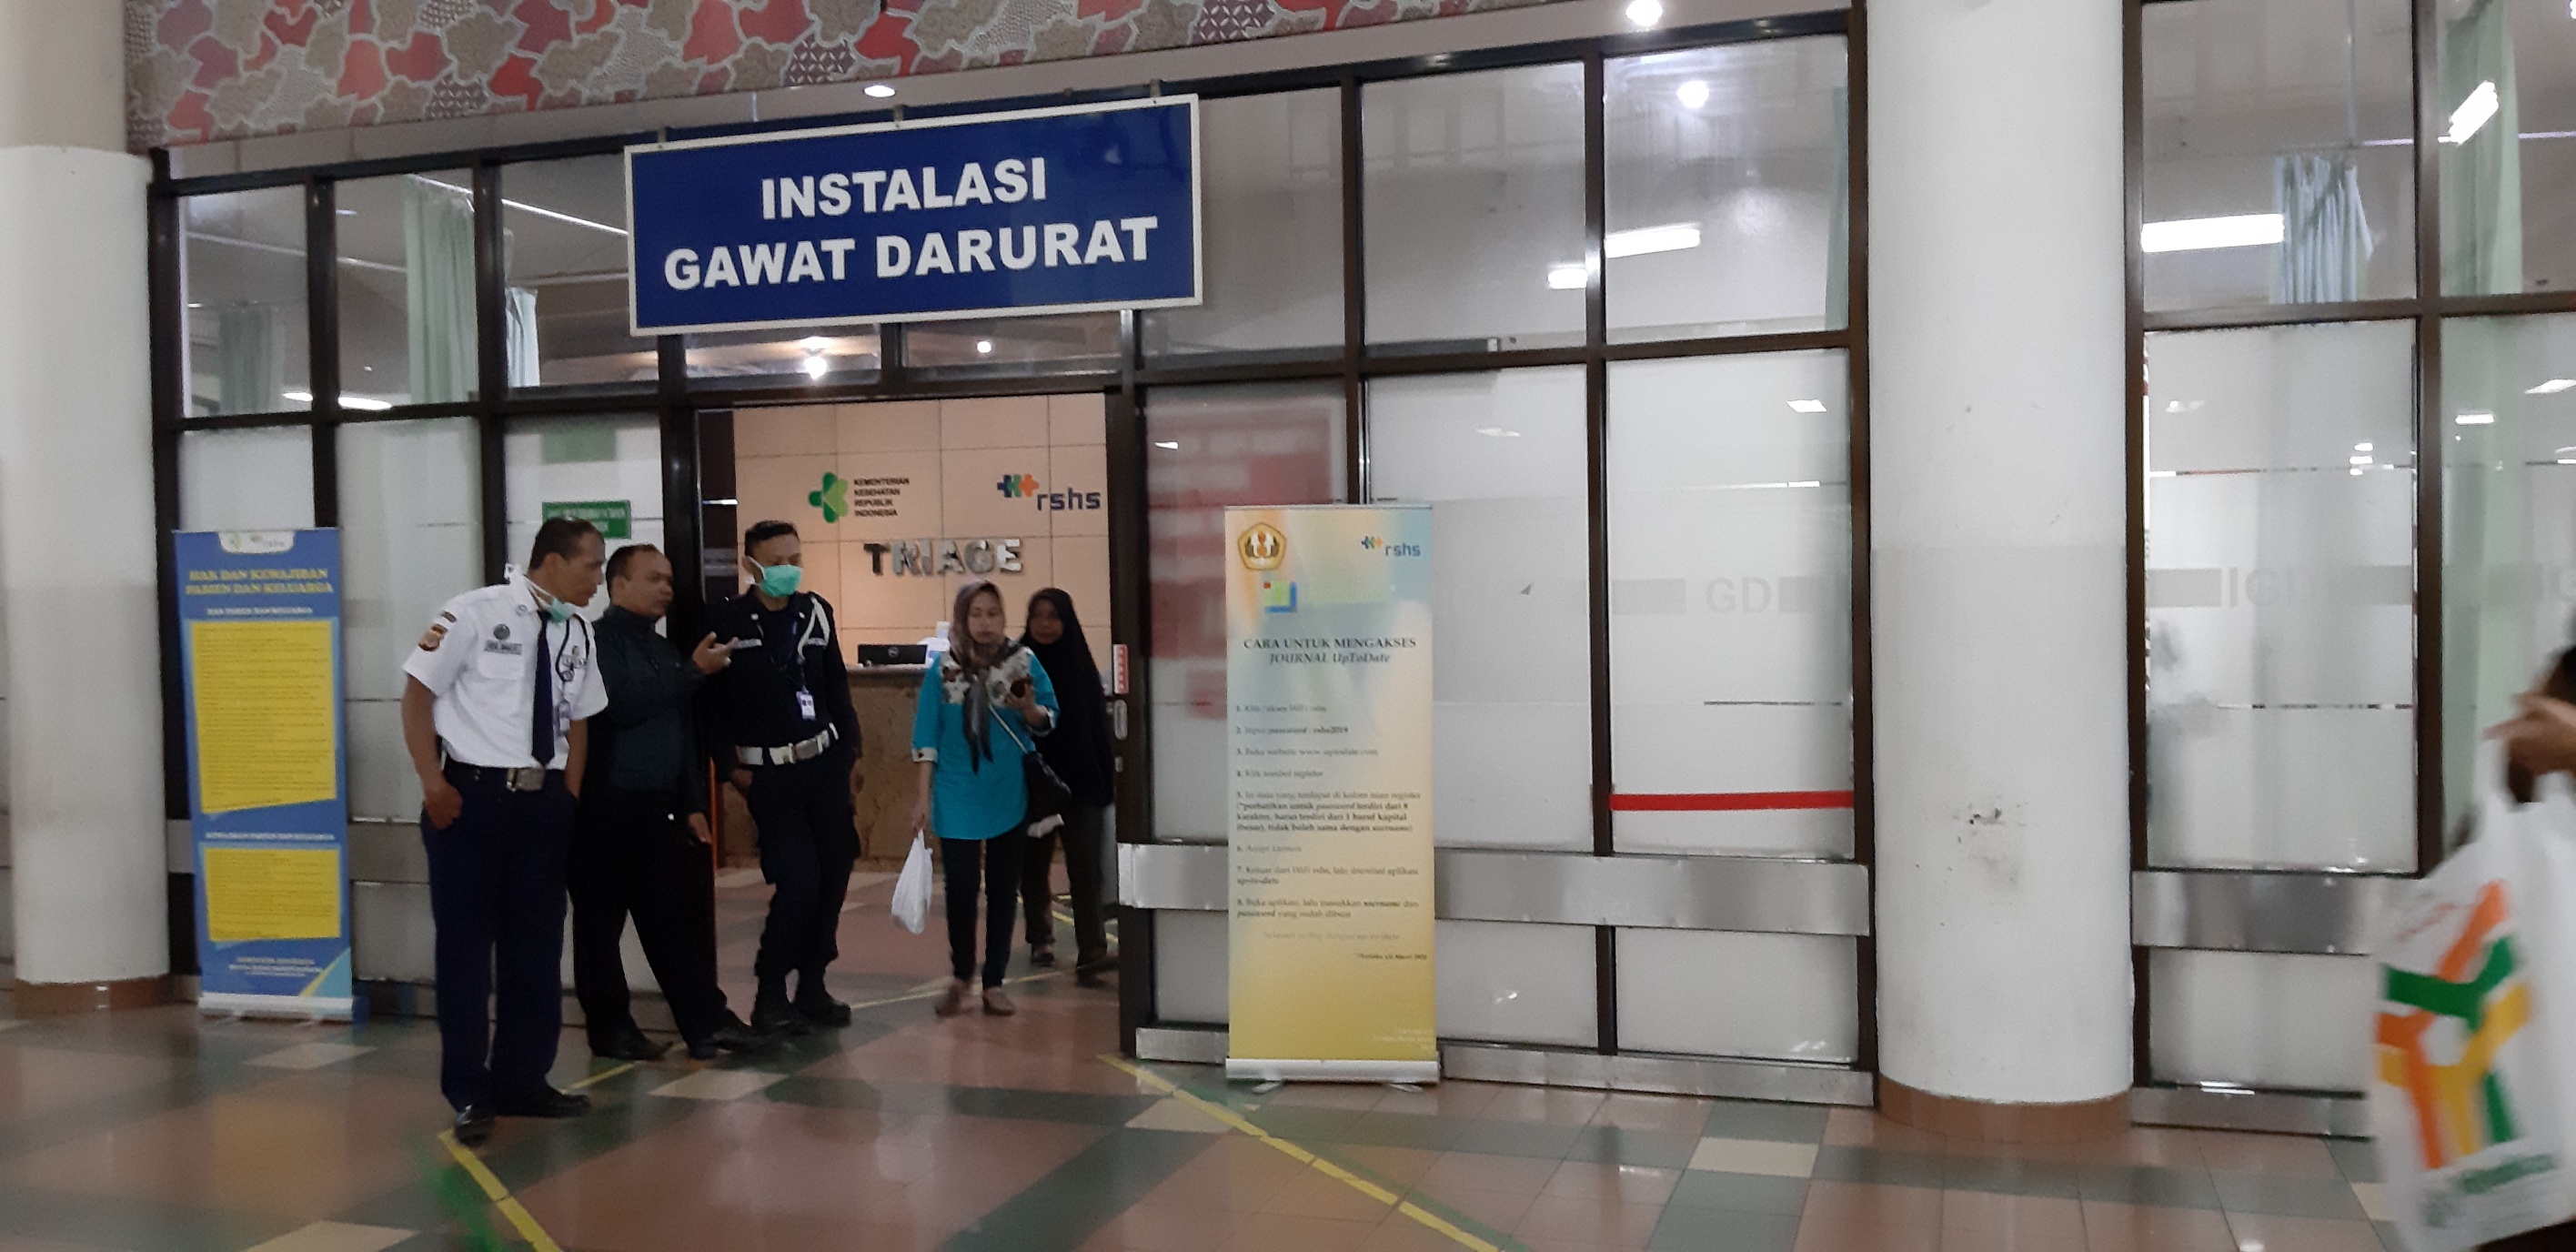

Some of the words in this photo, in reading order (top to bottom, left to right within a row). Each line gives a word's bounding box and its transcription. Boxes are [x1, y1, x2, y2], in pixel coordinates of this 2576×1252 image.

[761, 156, 1047, 220] INSTALASI
[664, 238, 855, 291] GAWAT
[875, 216, 1159, 279] DARURAT
[853, 477, 910, 486] KEMENTERIAN
[853, 488, 901, 498] KESEHATAN
[1037, 487, 1102, 511] rshs
[854, 499, 894, 508] REPUBLIK
[855, 509, 899, 518] INDONESIA
[1385, 543, 1421, 556] rshs
[863, 539, 1023, 577] TRIAGE
[1243, 638, 1280, 649] CARA
[1284, 638, 1330, 649] UNTUK
[1333, 638, 1416, 648] MENGAKSES
[1270, 653, 1328, 665] JOURNAL
[1333, 653, 1391, 664] UpToDate
